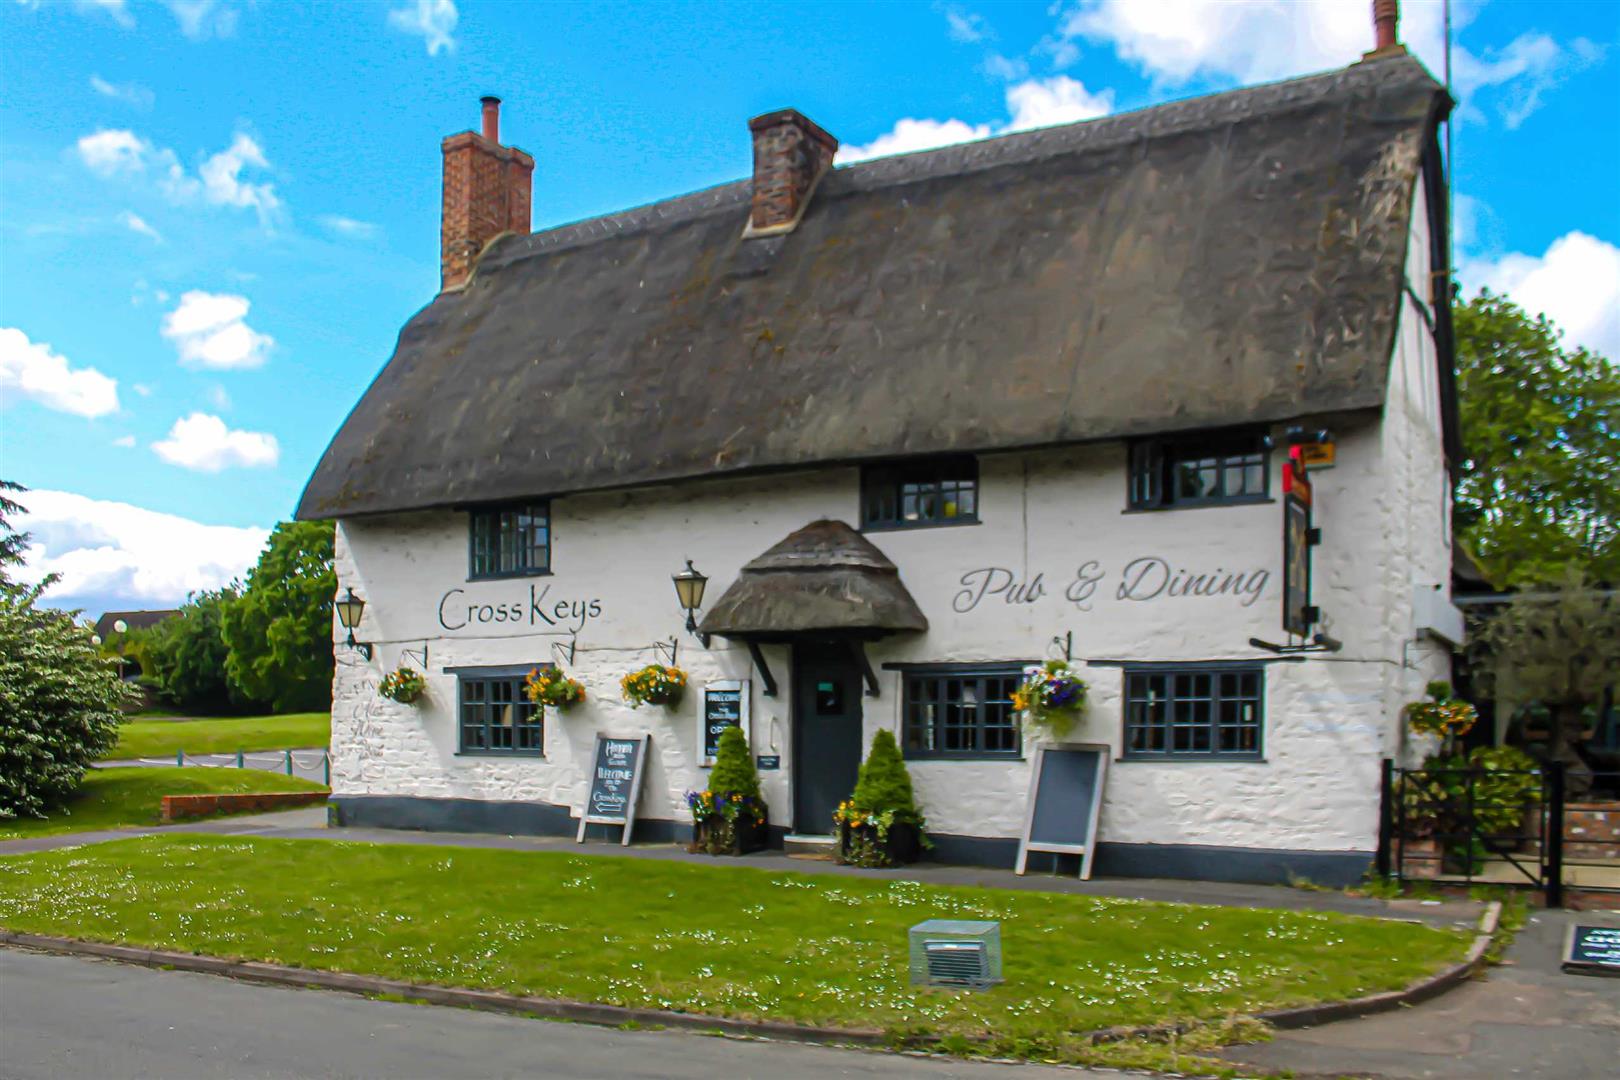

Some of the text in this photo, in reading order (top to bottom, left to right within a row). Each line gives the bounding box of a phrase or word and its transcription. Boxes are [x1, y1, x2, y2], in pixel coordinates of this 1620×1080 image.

[439, 584, 602, 634] Cross Keys
[952, 556, 1270, 613] Pub & Dining
